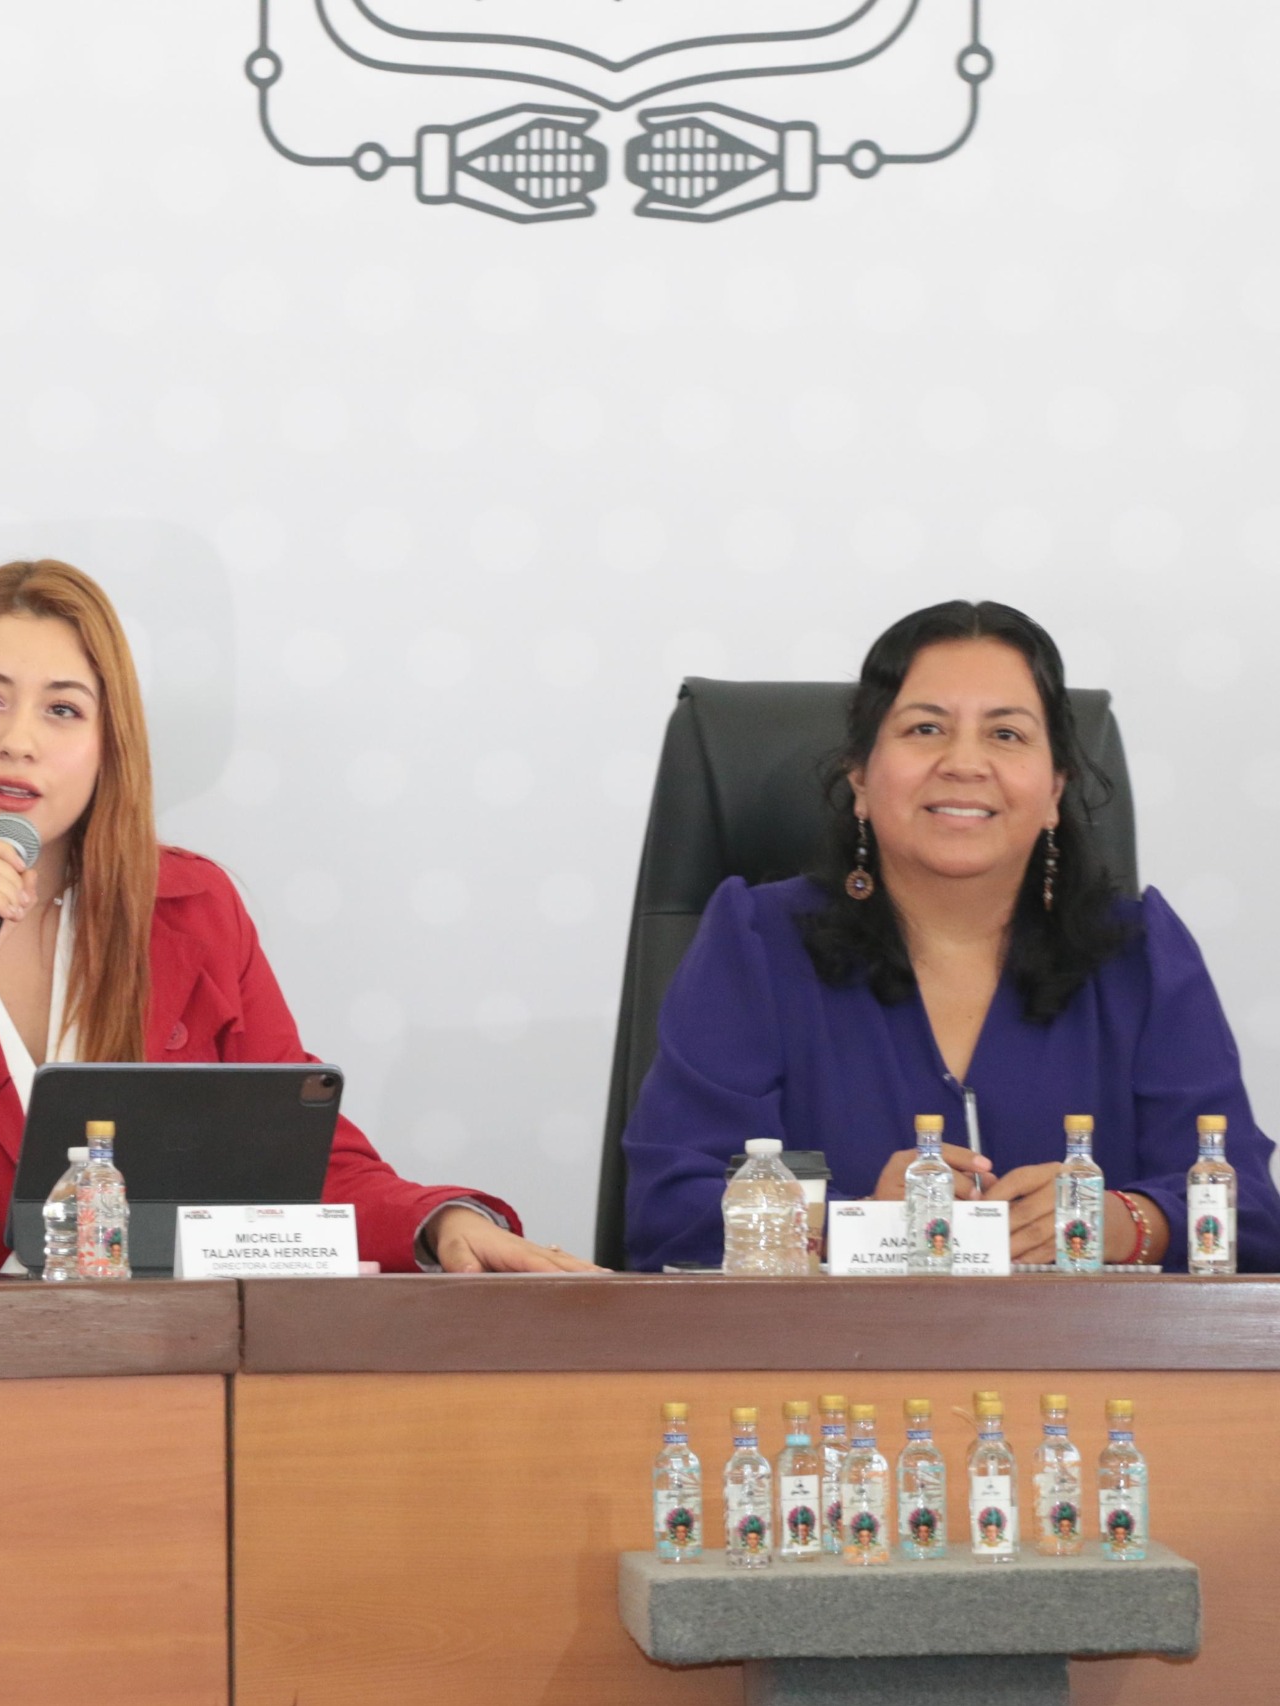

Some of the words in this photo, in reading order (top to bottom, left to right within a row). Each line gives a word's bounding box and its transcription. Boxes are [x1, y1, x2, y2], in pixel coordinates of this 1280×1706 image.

[235, 1233, 302, 1243] MICHELLE
[202, 1248, 270, 1258] TALAVERA
[274, 1247, 338, 1257] HERRERA
[212, 1262, 267, 1270] DIRECTORA
[270, 1261, 313, 1270] GENERAL
[315, 1261, 328, 1269] DE
